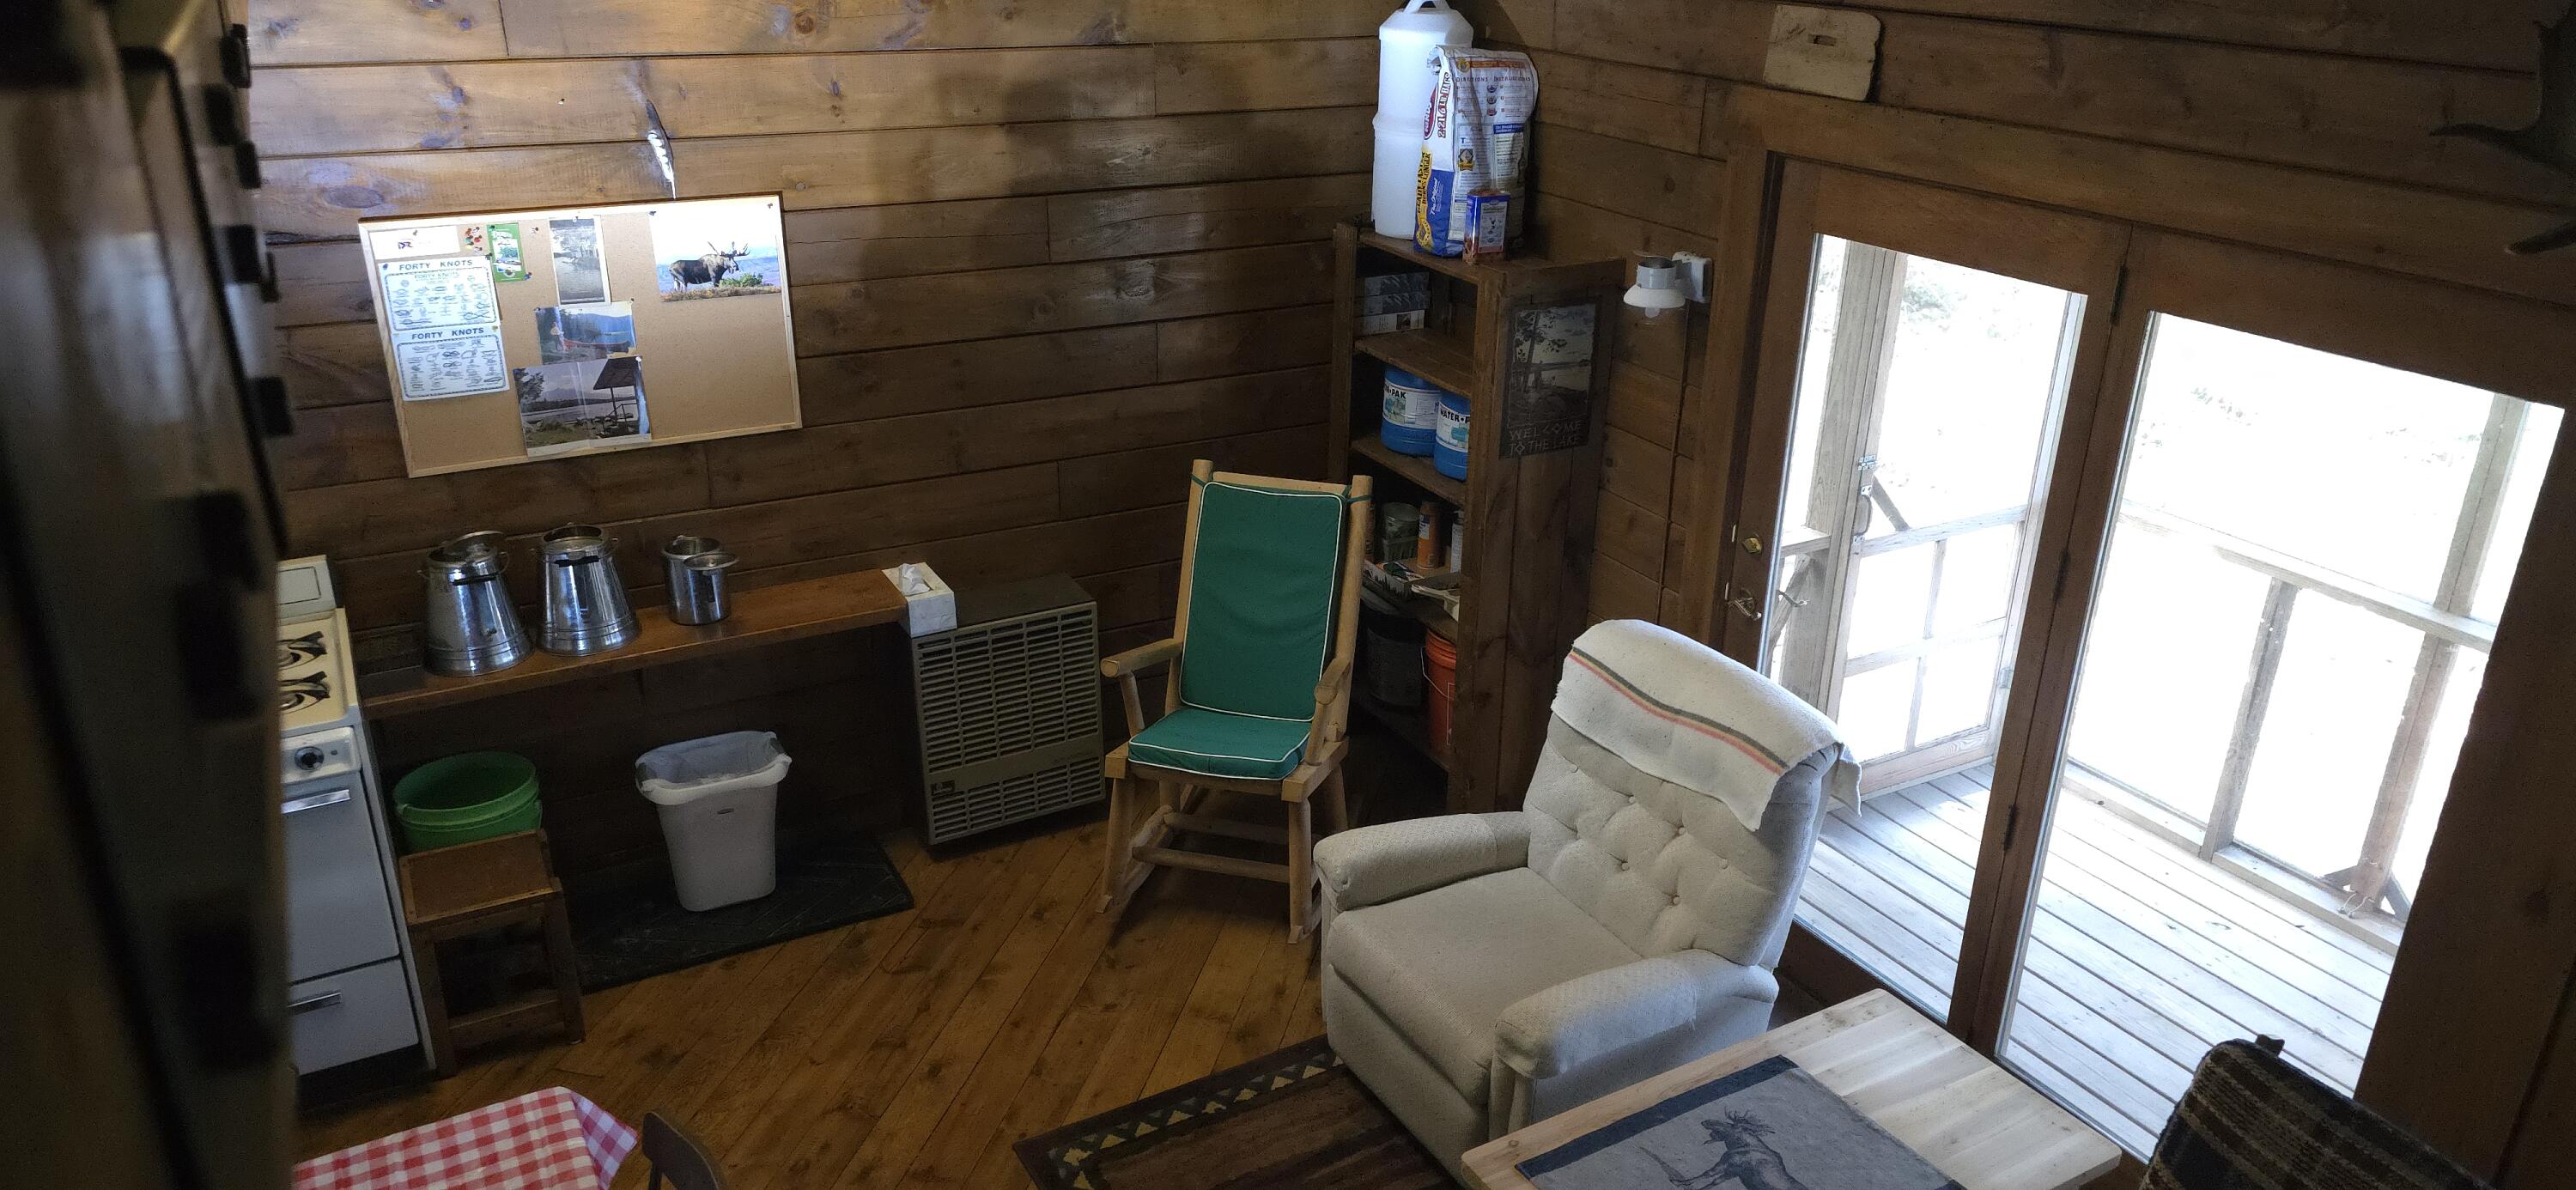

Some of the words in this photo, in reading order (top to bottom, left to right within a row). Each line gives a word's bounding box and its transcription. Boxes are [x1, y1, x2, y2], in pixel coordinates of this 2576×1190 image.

[398, 263, 431, 271] FORTY
[440, 259, 473, 268] KNOTS
[411, 331, 443, 341] FORTY
[452, 327, 484, 337] KNOTS
[1509, 421, 1580, 440] WELCOME
[1508, 441, 1526, 457] TO
[1528, 439, 1550, 453] THE
[1552, 434, 1581, 450] LAKE
